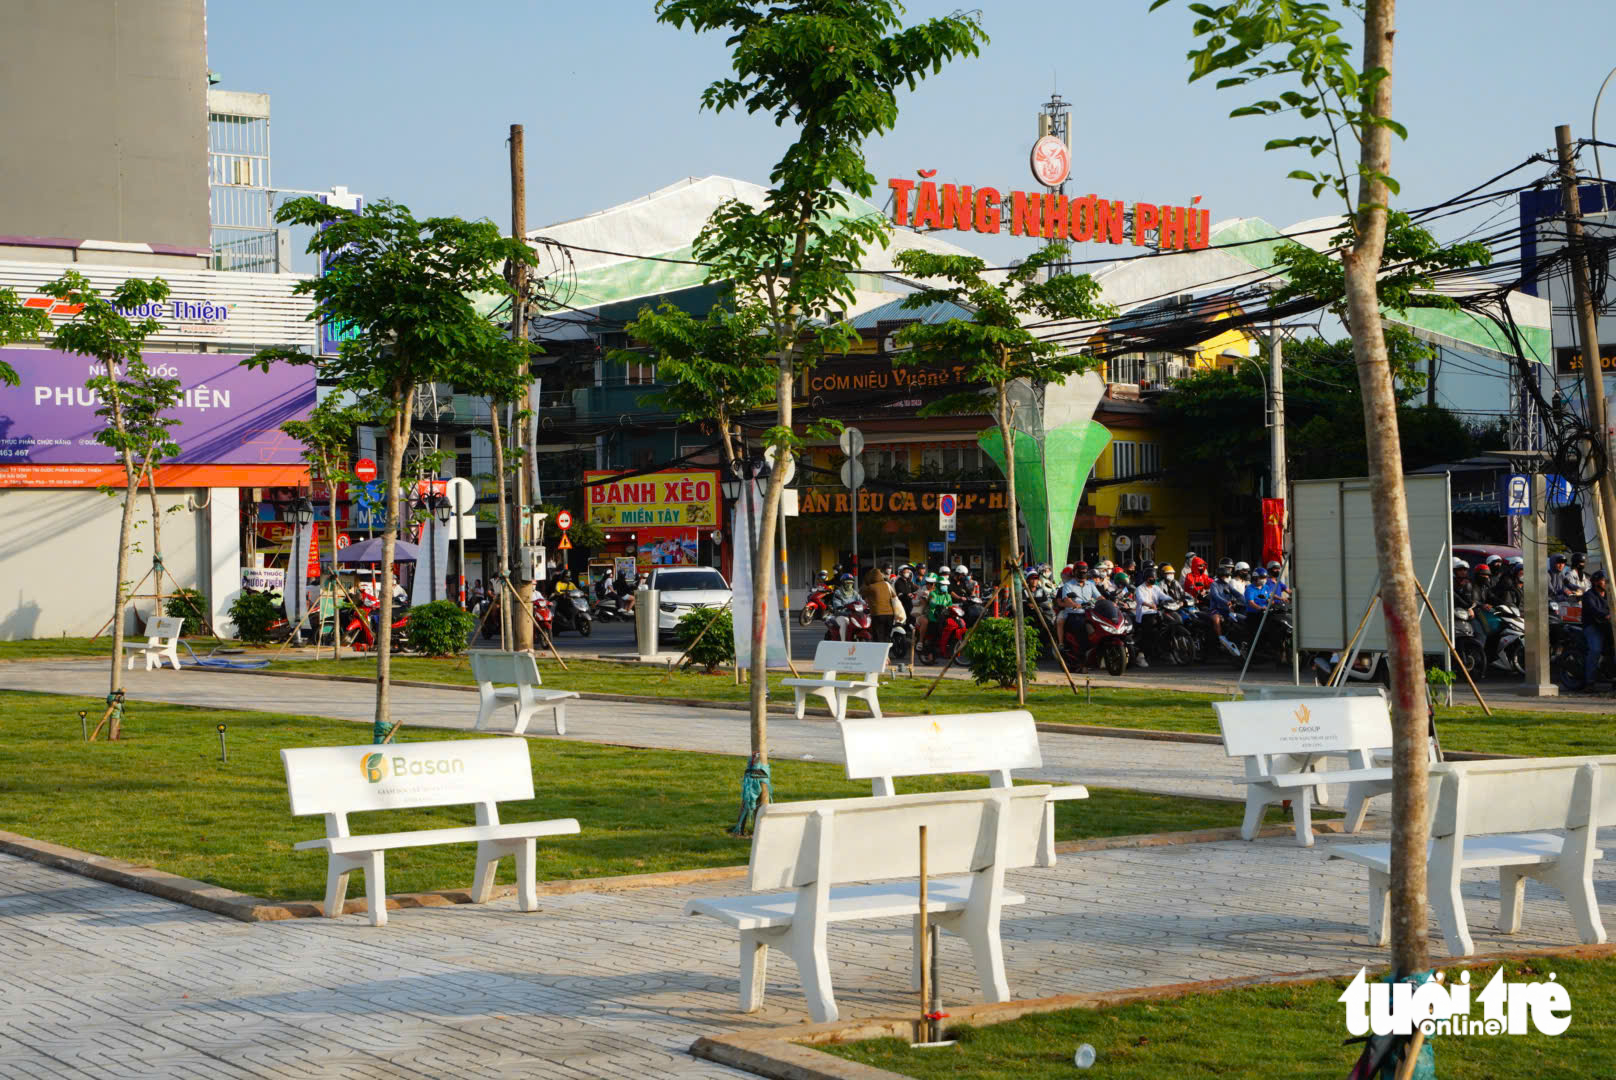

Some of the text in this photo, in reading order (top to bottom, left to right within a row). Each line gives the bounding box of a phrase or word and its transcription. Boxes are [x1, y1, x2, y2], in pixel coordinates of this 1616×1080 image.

[888, 169, 1210, 250] TĂNG NHƠN PHÚ
[173, 300, 227, 322] Thiện
[811, 374, 850, 392] CƠM
[853, 371, 888, 389] NIÊU
[591, 478, 711, 504] BÁNH XÈO
[798, 487, 831, 513] ẢN
[658, 508, 680, 523] TÂY
[392, 757, 465, 777] Basan
